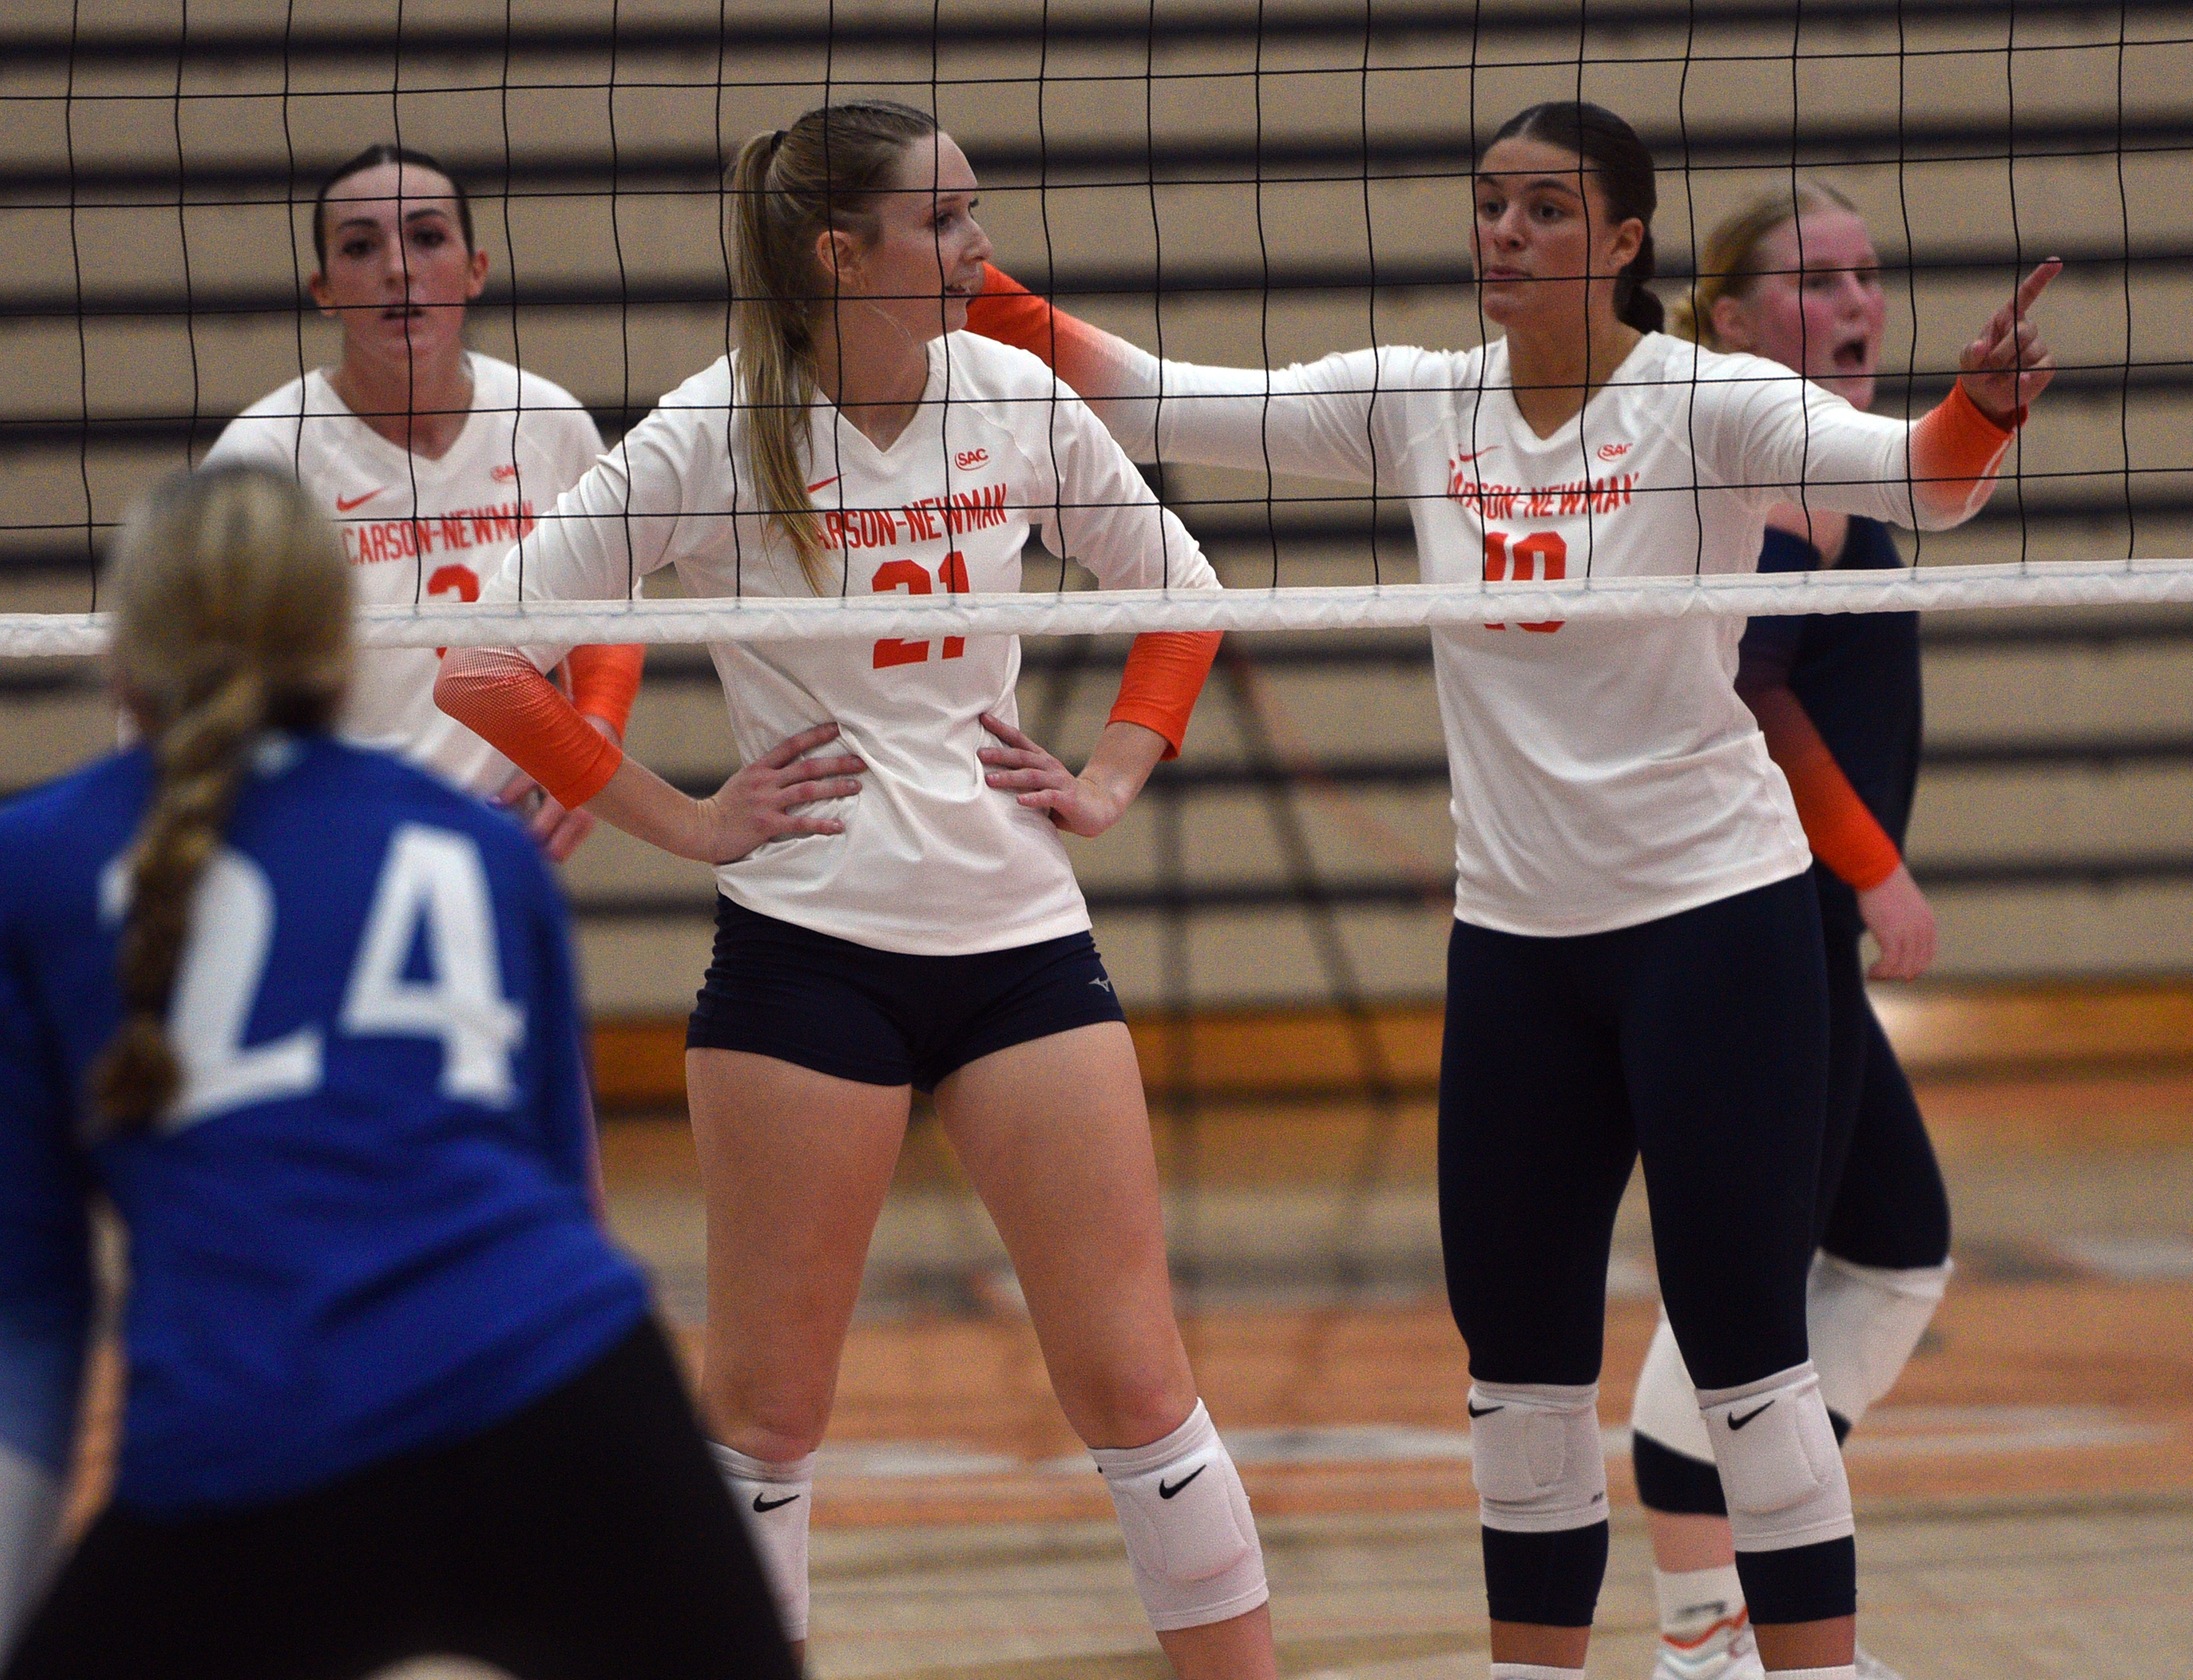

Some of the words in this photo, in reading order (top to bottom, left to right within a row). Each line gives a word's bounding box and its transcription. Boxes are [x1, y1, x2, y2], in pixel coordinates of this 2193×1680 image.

[956, 448, 989, 468] SAC
[803, 483, 1008, 551] RSON-NEWMAN
[871, 550, 970, 669] 21
[98, 822, 526, 1133] 24
